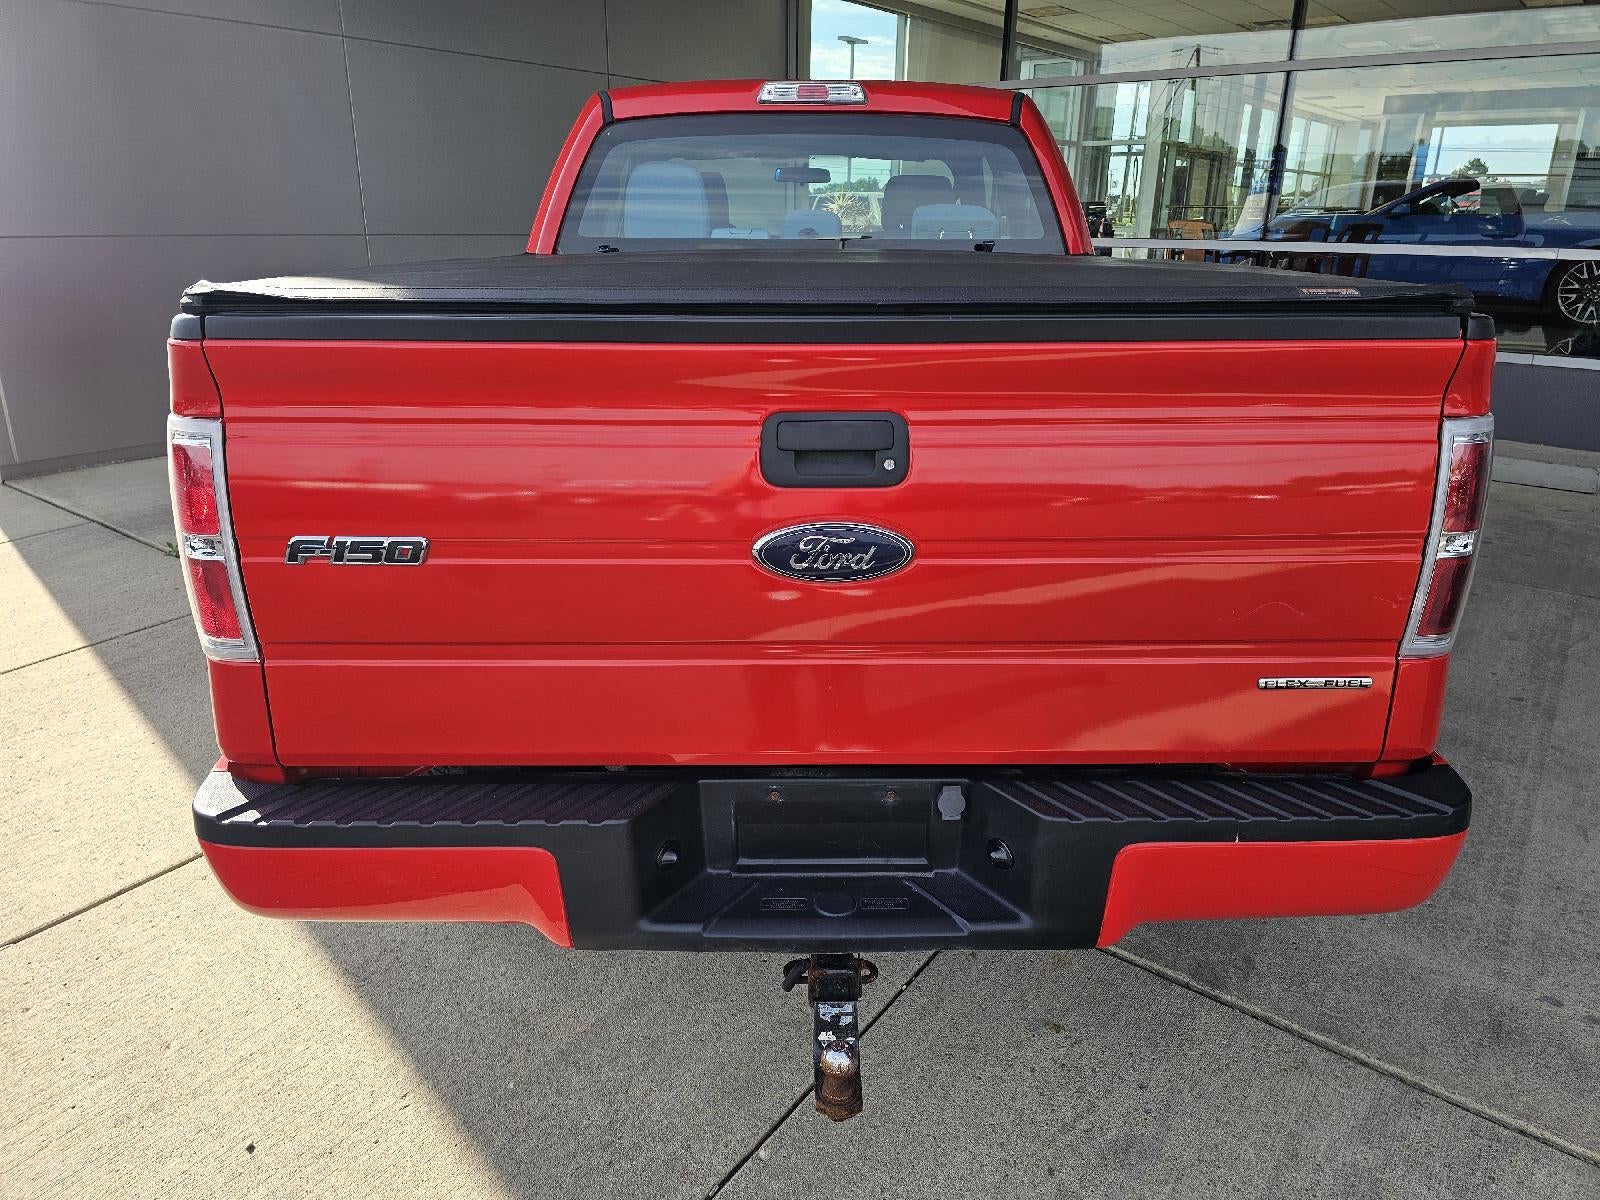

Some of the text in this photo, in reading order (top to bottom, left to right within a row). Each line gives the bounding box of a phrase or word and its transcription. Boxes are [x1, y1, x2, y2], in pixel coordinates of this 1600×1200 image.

[285, 535, 428, 566] F-150
[789, 534, 878, 570] Ford
[1263, 679, 1371, 689] FLEX FUEL
